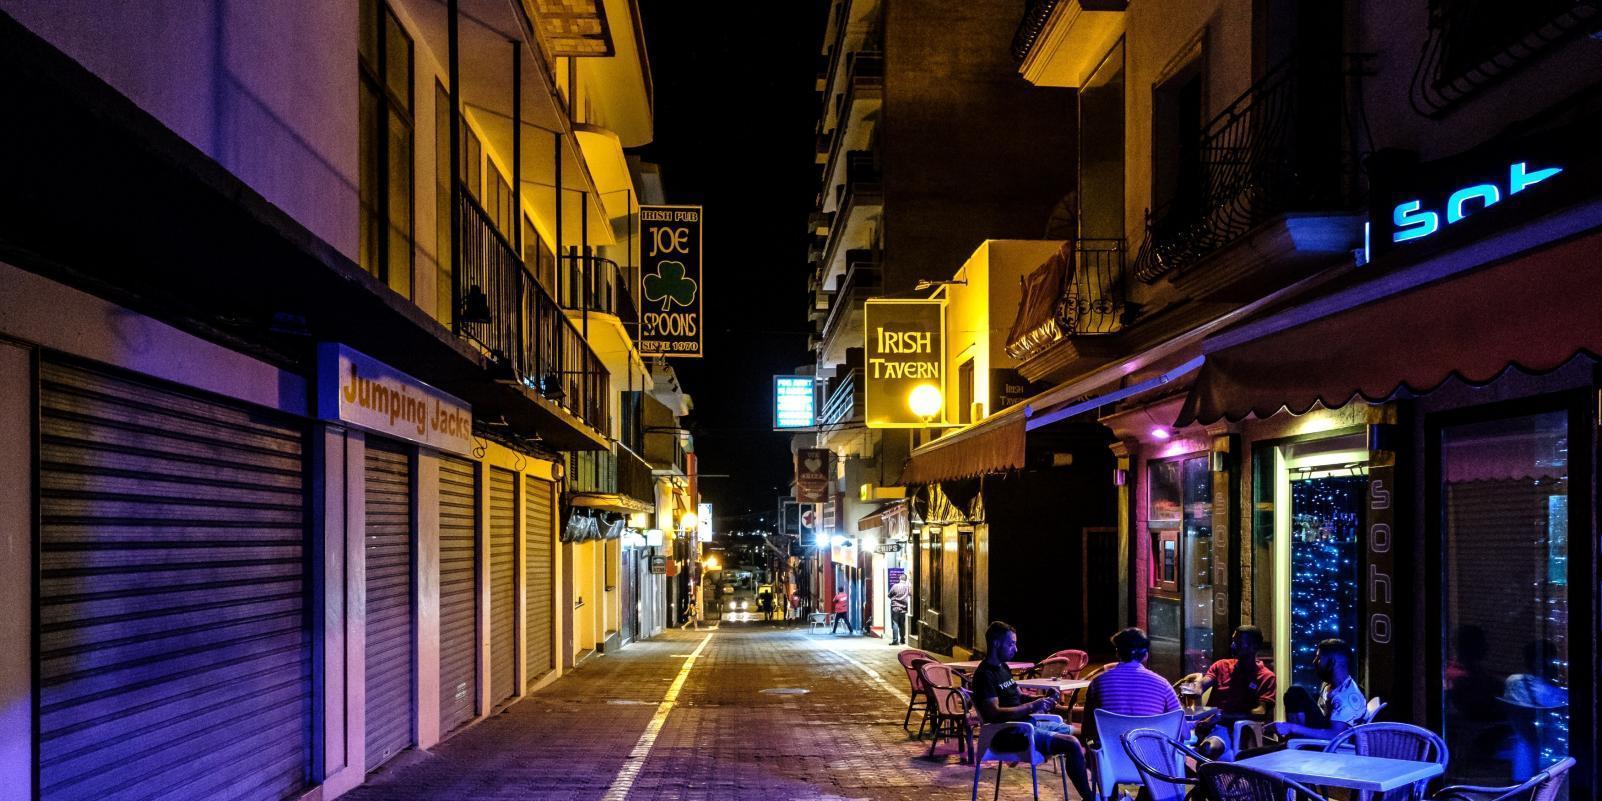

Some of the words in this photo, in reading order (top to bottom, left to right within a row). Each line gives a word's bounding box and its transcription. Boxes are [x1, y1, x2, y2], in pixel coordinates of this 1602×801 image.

[642, 210, 673, 222] IRISH
[674, 211, 698, 222] PUB
[649, 226, 690, 257] JOE
[643, 312, 697, 337] SPOONS
[672, 341, 699, 351] 1970
[877, 327, 931, 354] IRISH
[869, 358, 939, 379] TAVERN
[343, 363, 426, 435] Jumping
[431, 400, 470, 441] Jacks
[876, 544, 898, 552] CHIPS
